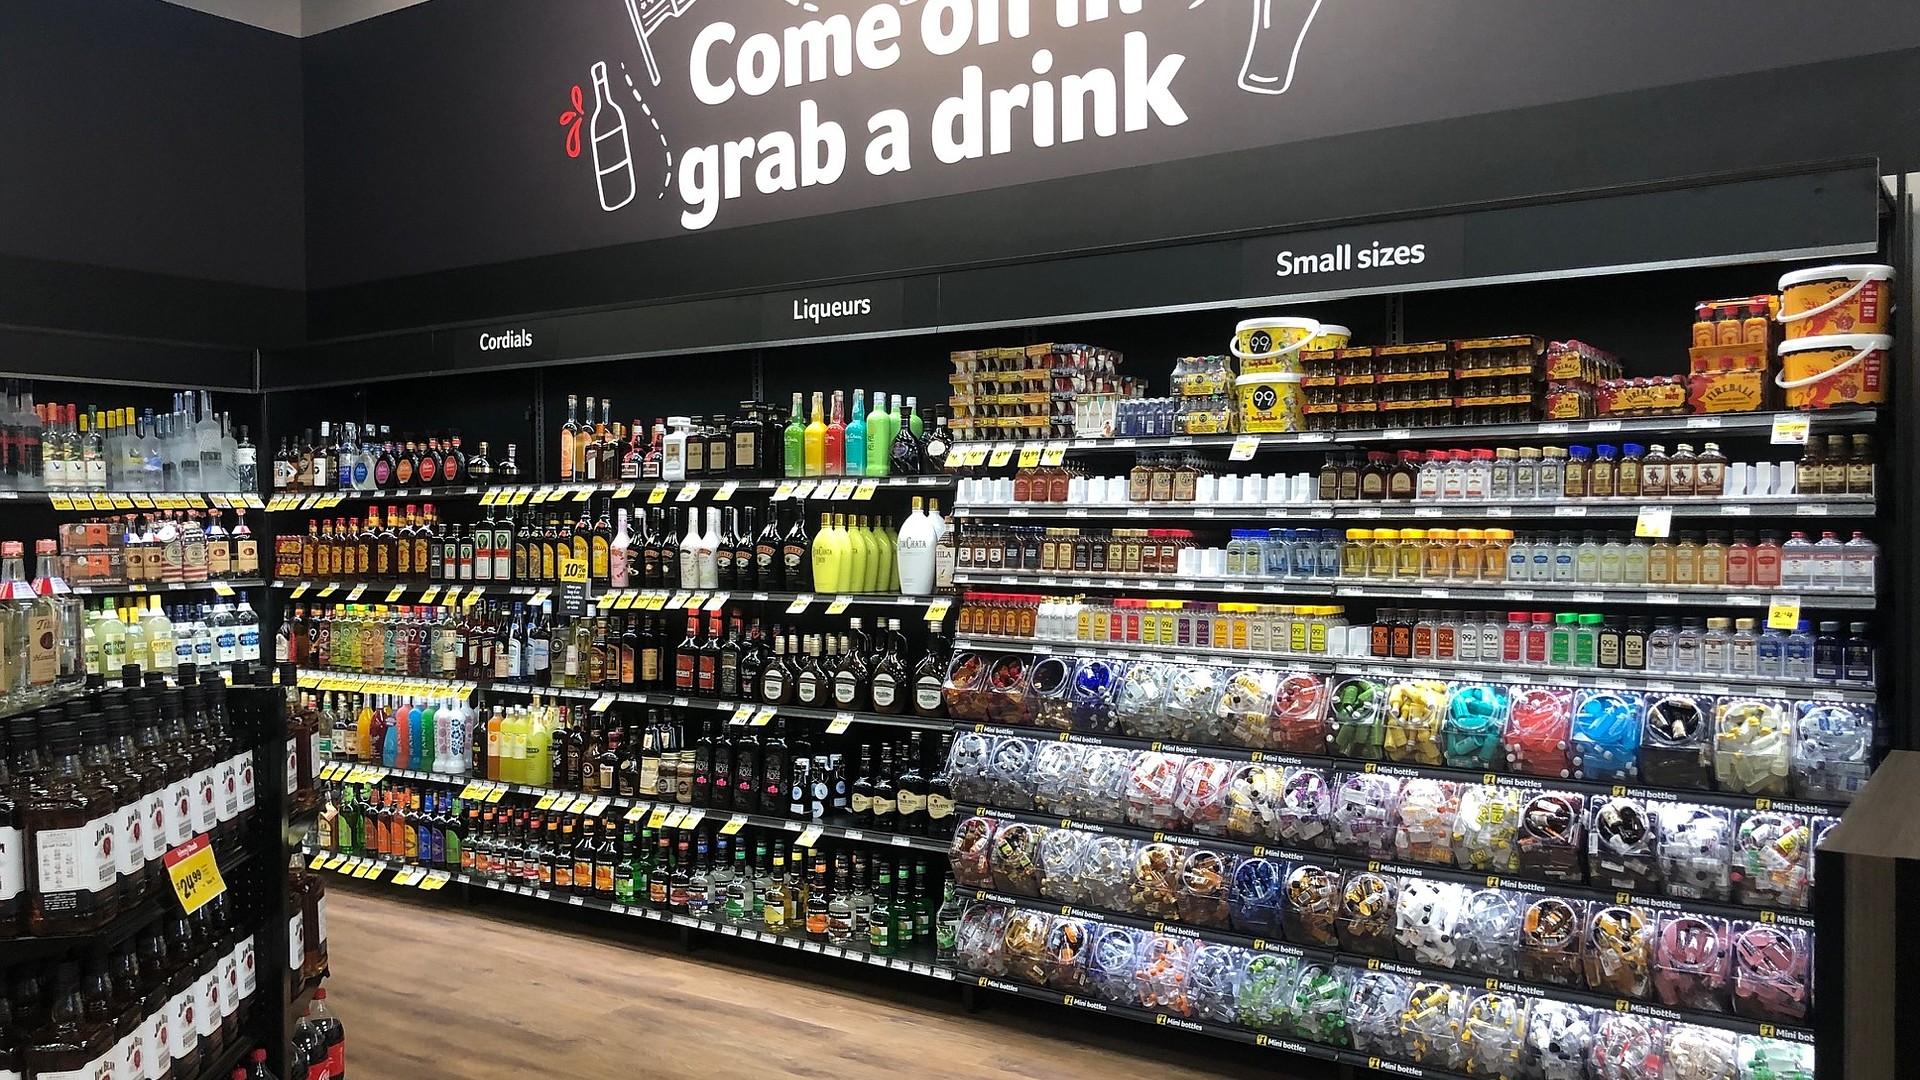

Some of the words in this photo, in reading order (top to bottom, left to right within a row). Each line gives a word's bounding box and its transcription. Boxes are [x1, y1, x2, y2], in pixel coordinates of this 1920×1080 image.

[689, 3, 902, 105] Come
[677, 99, 847, 230] grab
[864, 108, 912, 176] a
[931, 31, 1189, 164] drink
[1276, 243, 1351, 276] Small
[1357, 241, 1425, 269] sizes
[793, 298, 871, 324] Liqueurs
[479, 328, 533, 351] Cordials
[1251, 336, 1270, 352] 99
[1706, 384, 1755, 401] FIREBALL
[1254, 391, 1274, 407] 99
[996, 727, 1013, 735] bottles
[1082, 736, 1101, 744] bottles
[1162, 744, 1175, 752] Mini
[1176, 746, 1197, 754] bottles
[1263, 754, 1277, 762] Mini
[1278, 755, 1301, 764] bottles
[1377, 766, 1393, 774] Mini
[1395, 767, 1418, 776] bottles
[1497, 778, 1513, 786] Mini
[1515, 779, 1542, 788] bottles
[1628, 789, 1645, 797] Mini
[1647, 790, 1677, 800] bottles
[1772, 802, 1793, 812] Mini
[1795, 803, 1828, 815] bottles
[986, 810, 996, 818] Mini
[998, 811, 1015, 819] bottles
[1071, 821, 1083, 830] Mini
[1084, 823, 1103, 832] bottles
[1178, 837, 1199, 846] bottles
[1265, 849, 1279, 857] Mini
[1281, 851, 1303, 860] bottles
[1380, 865, 1396, 874] Mini
[1398, 866, 1422, 876] bottles
[1501, 880, 1516, 889] Mini
[1518, 882, 1545, 892] bottles
[998, 896, 1016, 904] bottles
[1631, 897, 1649, 905] Mini
[1651, 898, 1681, 909] bottles
[1085, 911, 1104, 920] bottles
[1777, 915, 1797, 925] Mini
[1164, 926, 1177, 934] Mini
[1179, 928, 1199, 937] bottles
[1266, 943, 1279, 951] Mini
[1281, 945, 1303, 956] bottles
[1380, 963, 1395, 972] Mini
[1397, 965, 1421, 975] bottles
[1000, 982, 1018, 991] bottles
[1500, 983, 1515, 992] Mini
[1518, 985, 1544, 996] bottles
[1087, 1001, 1106, 1010] bottles
[1631, 1005, 1648, 1014] Mini
[1651, 1006, 1681, 1019] bottles
[1167, 1018, 1180, 1026] Mini
[1182, 1020, 1202, 1031] bottles
[1776, 1029, 1796, 1038] Mini
[1268, 1038, 1282, 1047] Mini
[1283, 1041, 1306, 1052] bottles
[1381, 1062, 1397, 1071] Mini
[1398, 1064, 1422, 1076] bottles
